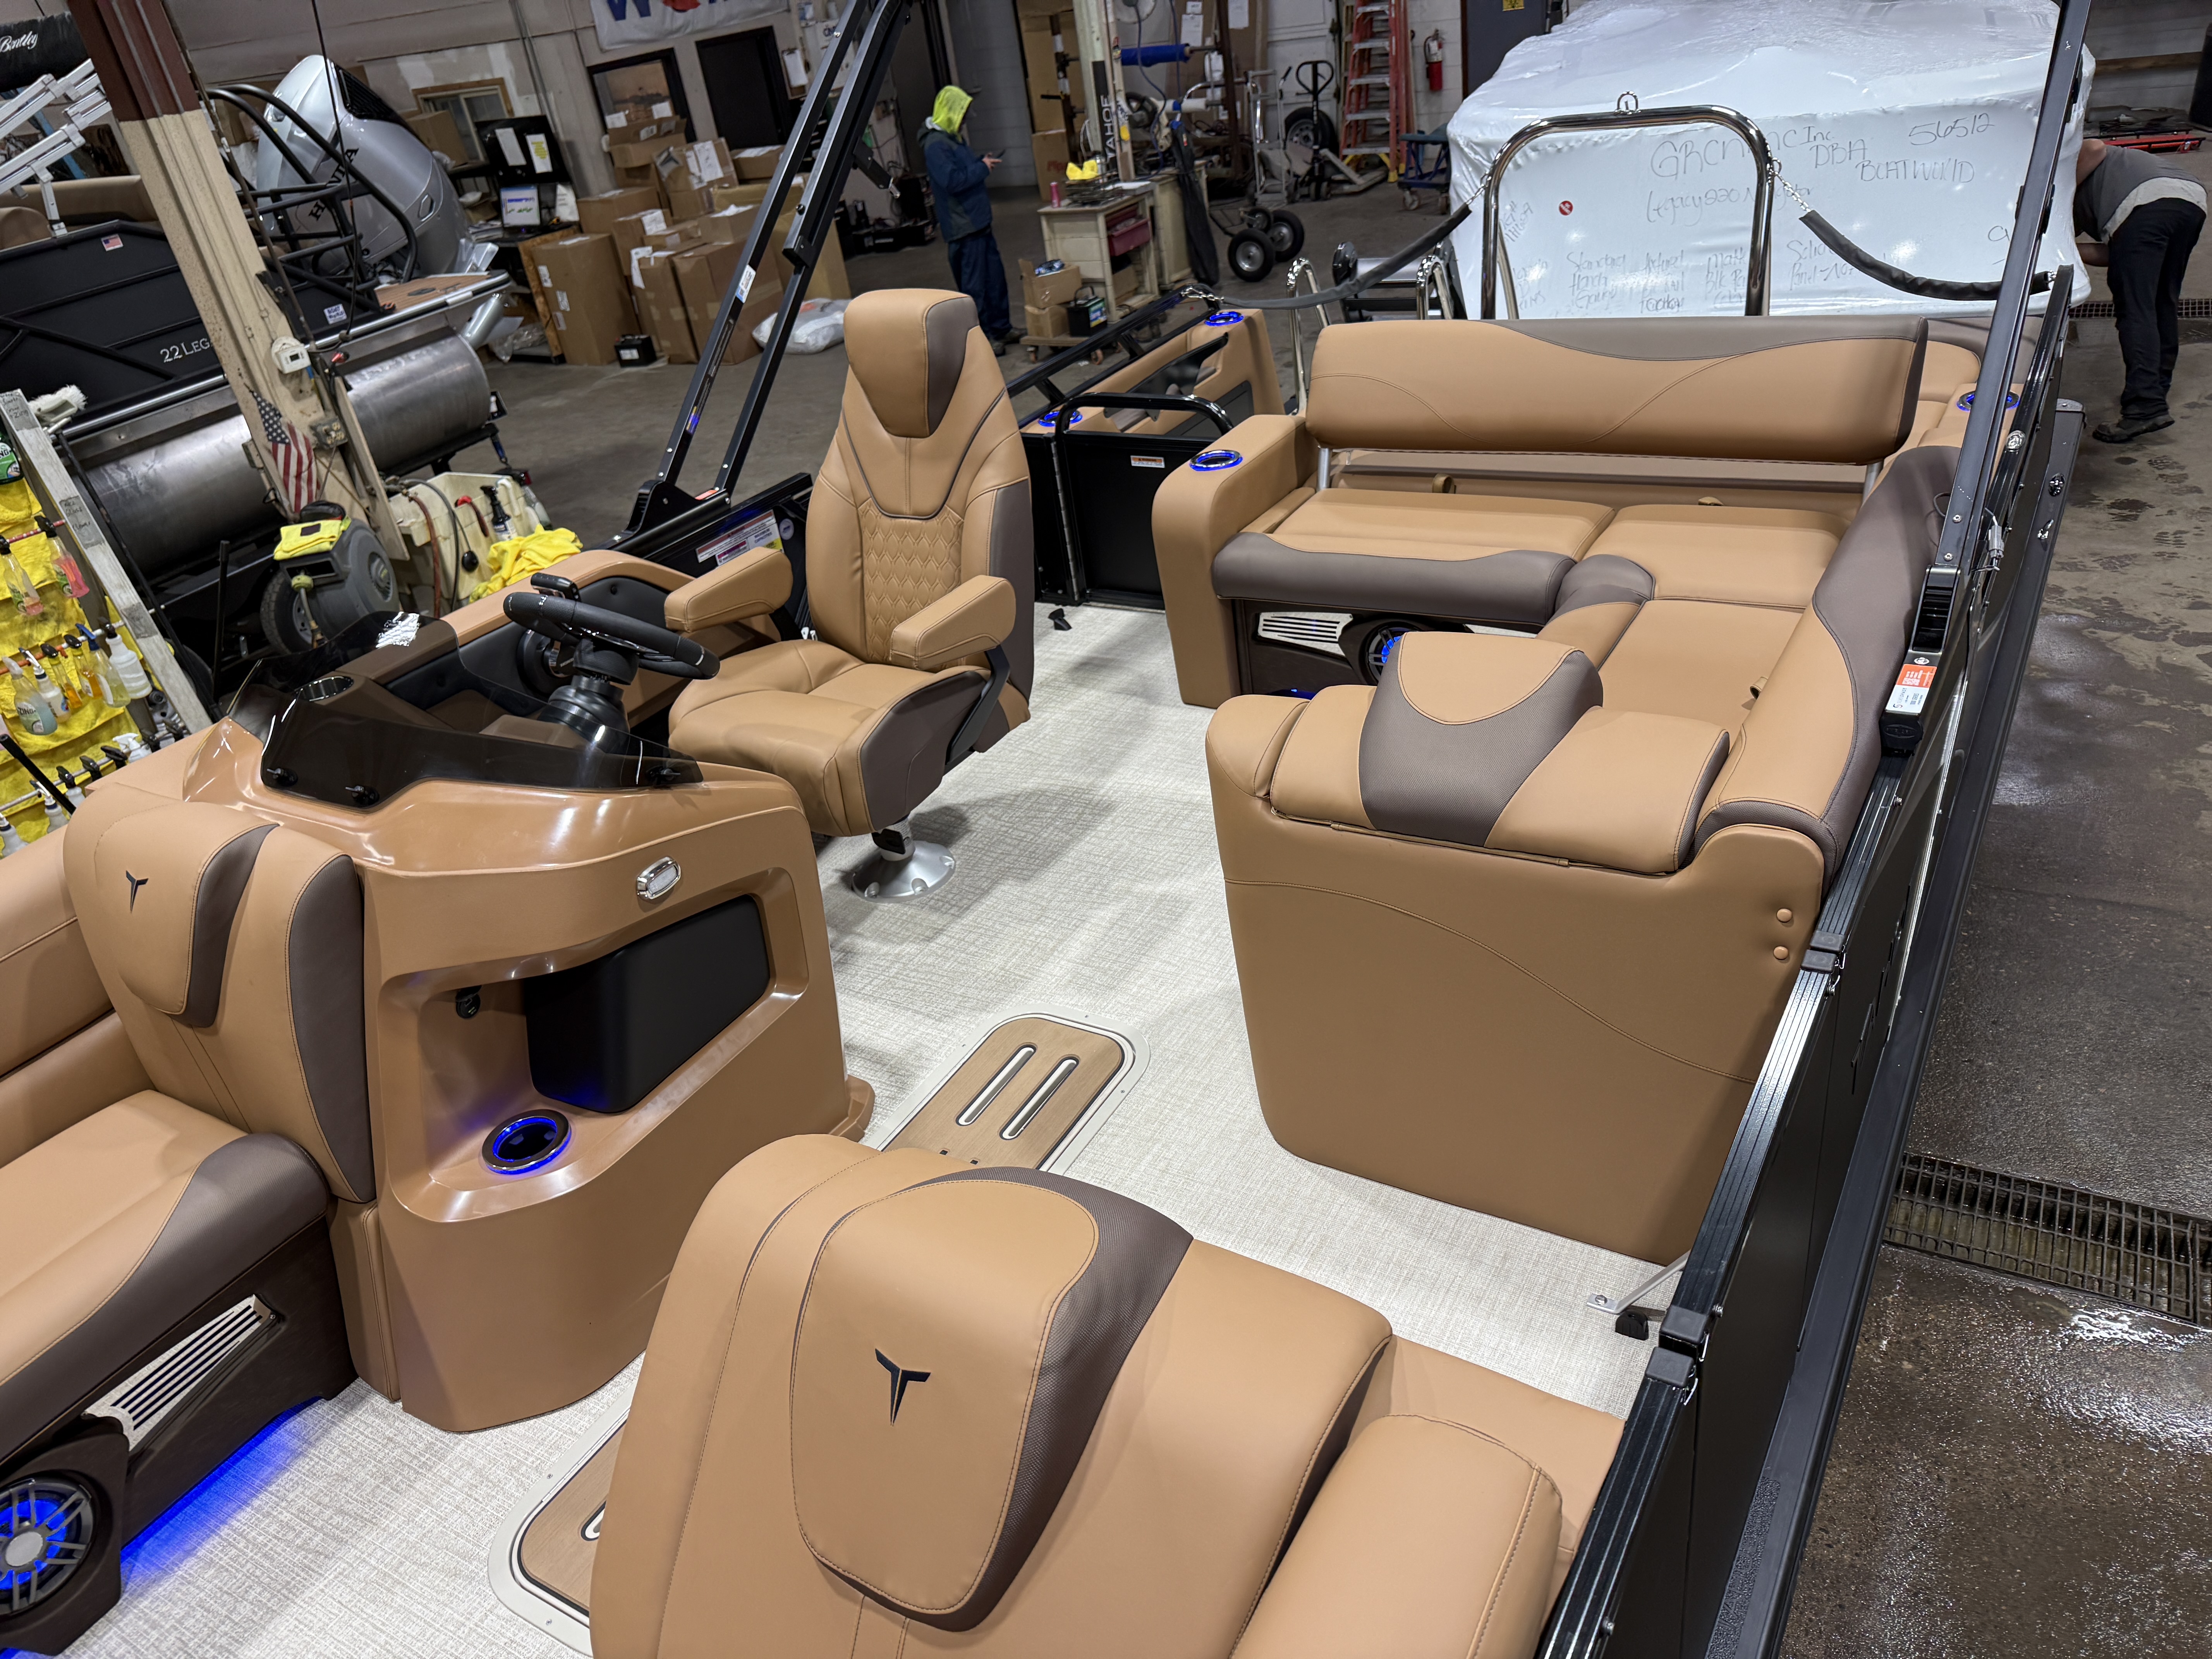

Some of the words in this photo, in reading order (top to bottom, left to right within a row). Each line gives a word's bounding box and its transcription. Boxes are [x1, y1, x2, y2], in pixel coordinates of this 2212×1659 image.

[1909, 113, 1995, 146] 56512
[1809, 139, 1868, 168] DBA
[180, 338, 213, 356] LEG
